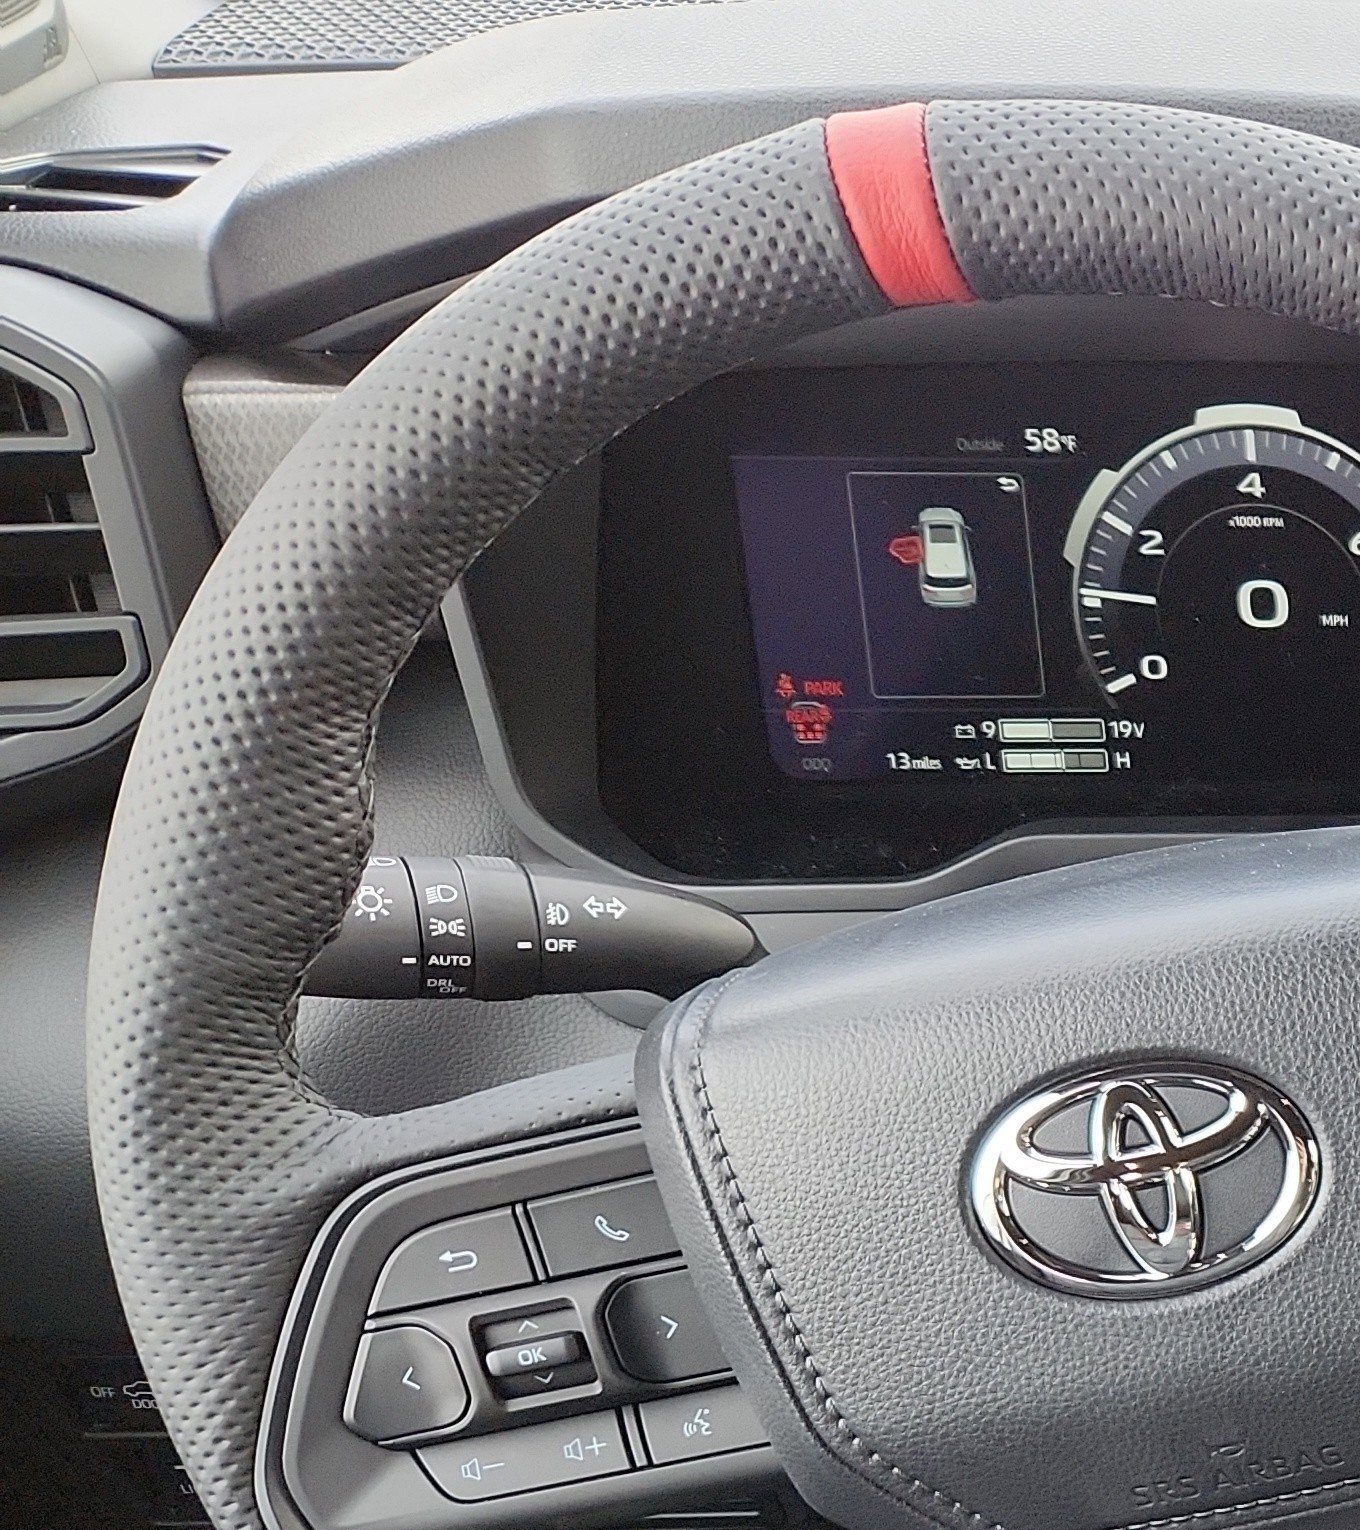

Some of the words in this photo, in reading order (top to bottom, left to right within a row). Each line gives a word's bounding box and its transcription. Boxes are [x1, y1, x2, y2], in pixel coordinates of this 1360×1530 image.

[1236, 471, 1267, 498] 4
[1263, 516, 1285, 529] RPM
[1138, 528, 1166, 557] 2
[1236, 578, 1292, 630] 0
[1320, 613, 1350, 628] MPH
[1139, 654, 1169, 681] 0
[980, 720, 997, 739] 9
[1107, 719, 1145, 739] 19V
[886, 752, 912, 771] 13
[911, 755, 943, 771] miles
[984, 752, 997, 771] L
[1113, 752, 1132, 771] H
[544, 938, 578, 954] OFF
[427, 954, 472, 969] AUTO
[426, 977, 456, 989] DRL
[439, 984, 468, 995] OFF
[517, 1347, 548, 1368] OK
[90, 1386, 117, 1399] OFF
